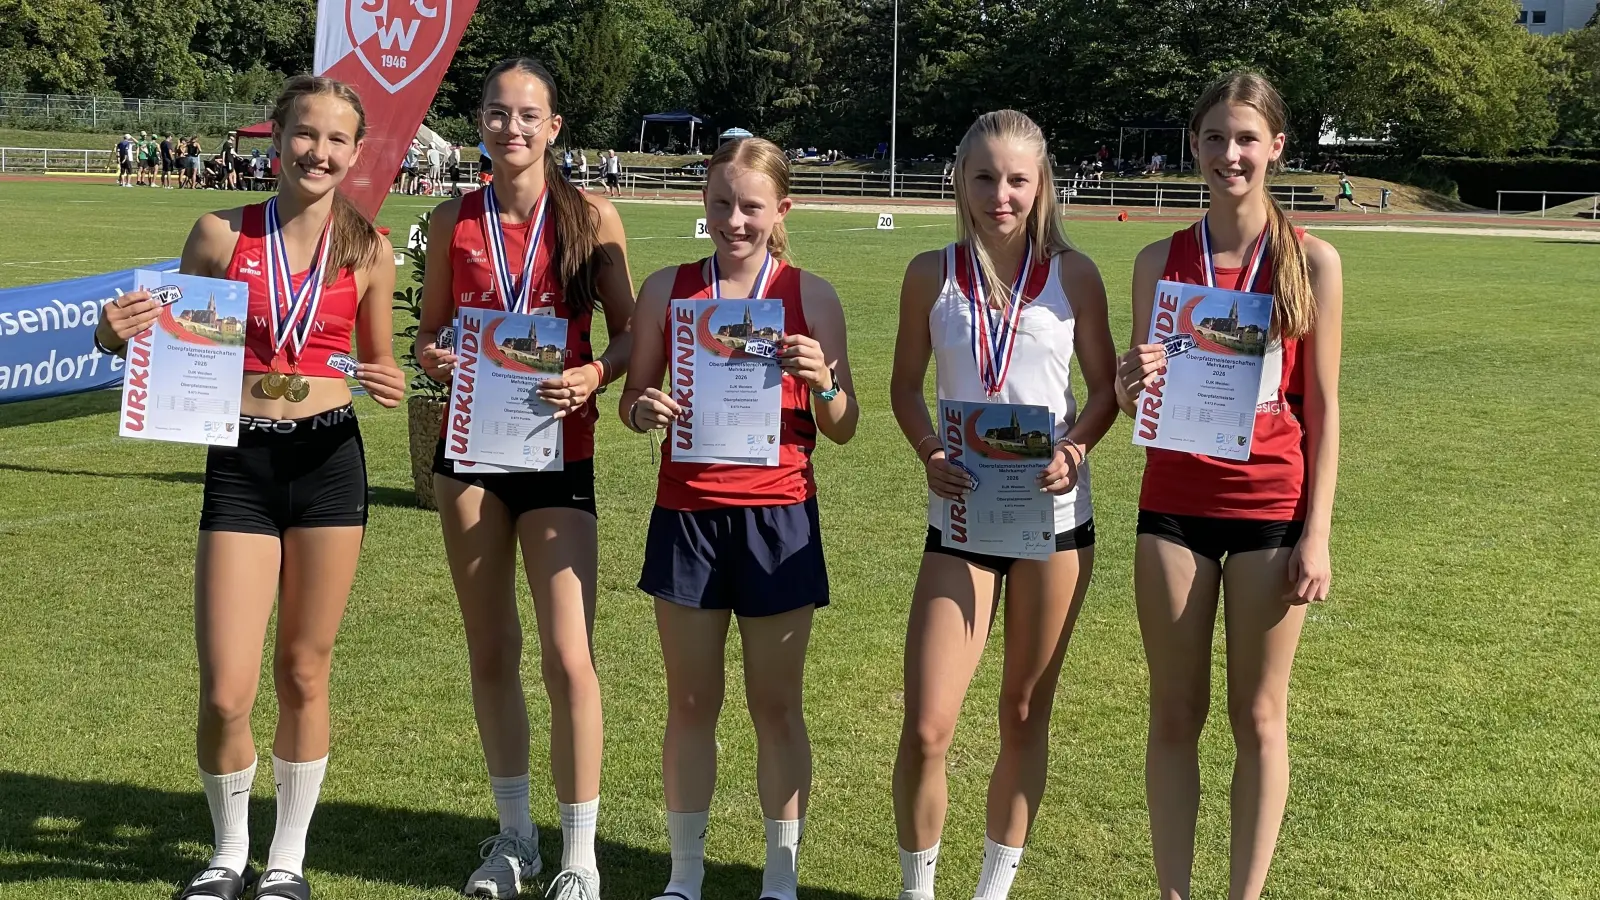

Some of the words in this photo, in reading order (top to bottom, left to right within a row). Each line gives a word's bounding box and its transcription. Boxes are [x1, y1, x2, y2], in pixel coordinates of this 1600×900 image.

[374, 16, 420, 51] W
[381, 55, 407, 69] 1946
[879, 216, 892, 227] 20
[240, 267, 262, 276] erima
[125, 285, 153, 432] URKUN
[1185, 354, 1256, 367] Oberpfalzmeisterschaften
[1206, 362, 1235, 370] Mehrkampf
[450, 315, 481, 454] URKUNDE
[676, 306, 695, 450] URKUNDE
[240, 416, 297, 434] PRO
[311, 403, 354, 430] NIK
[200, 869, 227, 880] NIKE
[267, 871, 295, 881] NIKE
